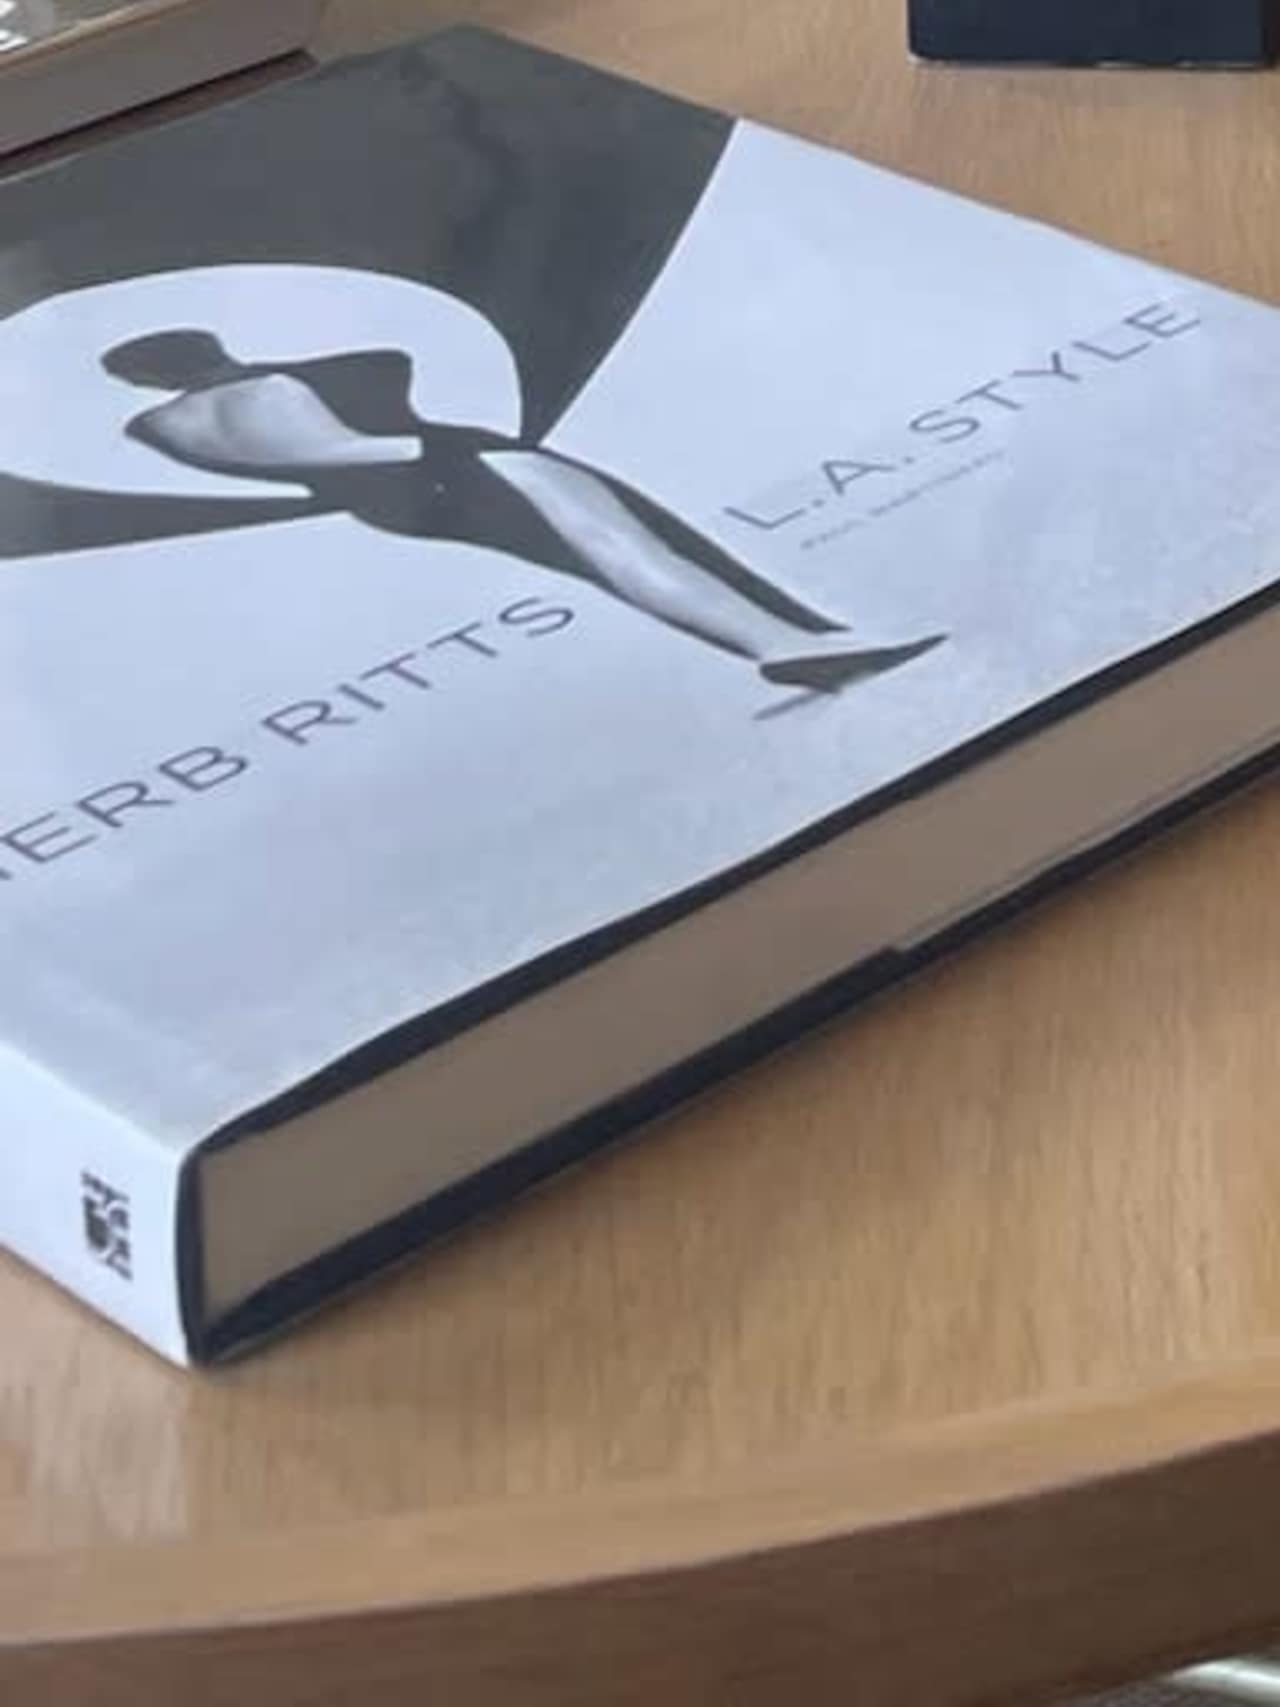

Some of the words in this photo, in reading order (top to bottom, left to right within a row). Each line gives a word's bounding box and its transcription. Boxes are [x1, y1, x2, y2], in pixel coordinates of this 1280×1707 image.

[724, 452, 916, 530] L.A.
[909, 302, 1203, 445] STYLE
[0, 744, 249, 881] ERB
[260, 596, 575, 746] RITTS
